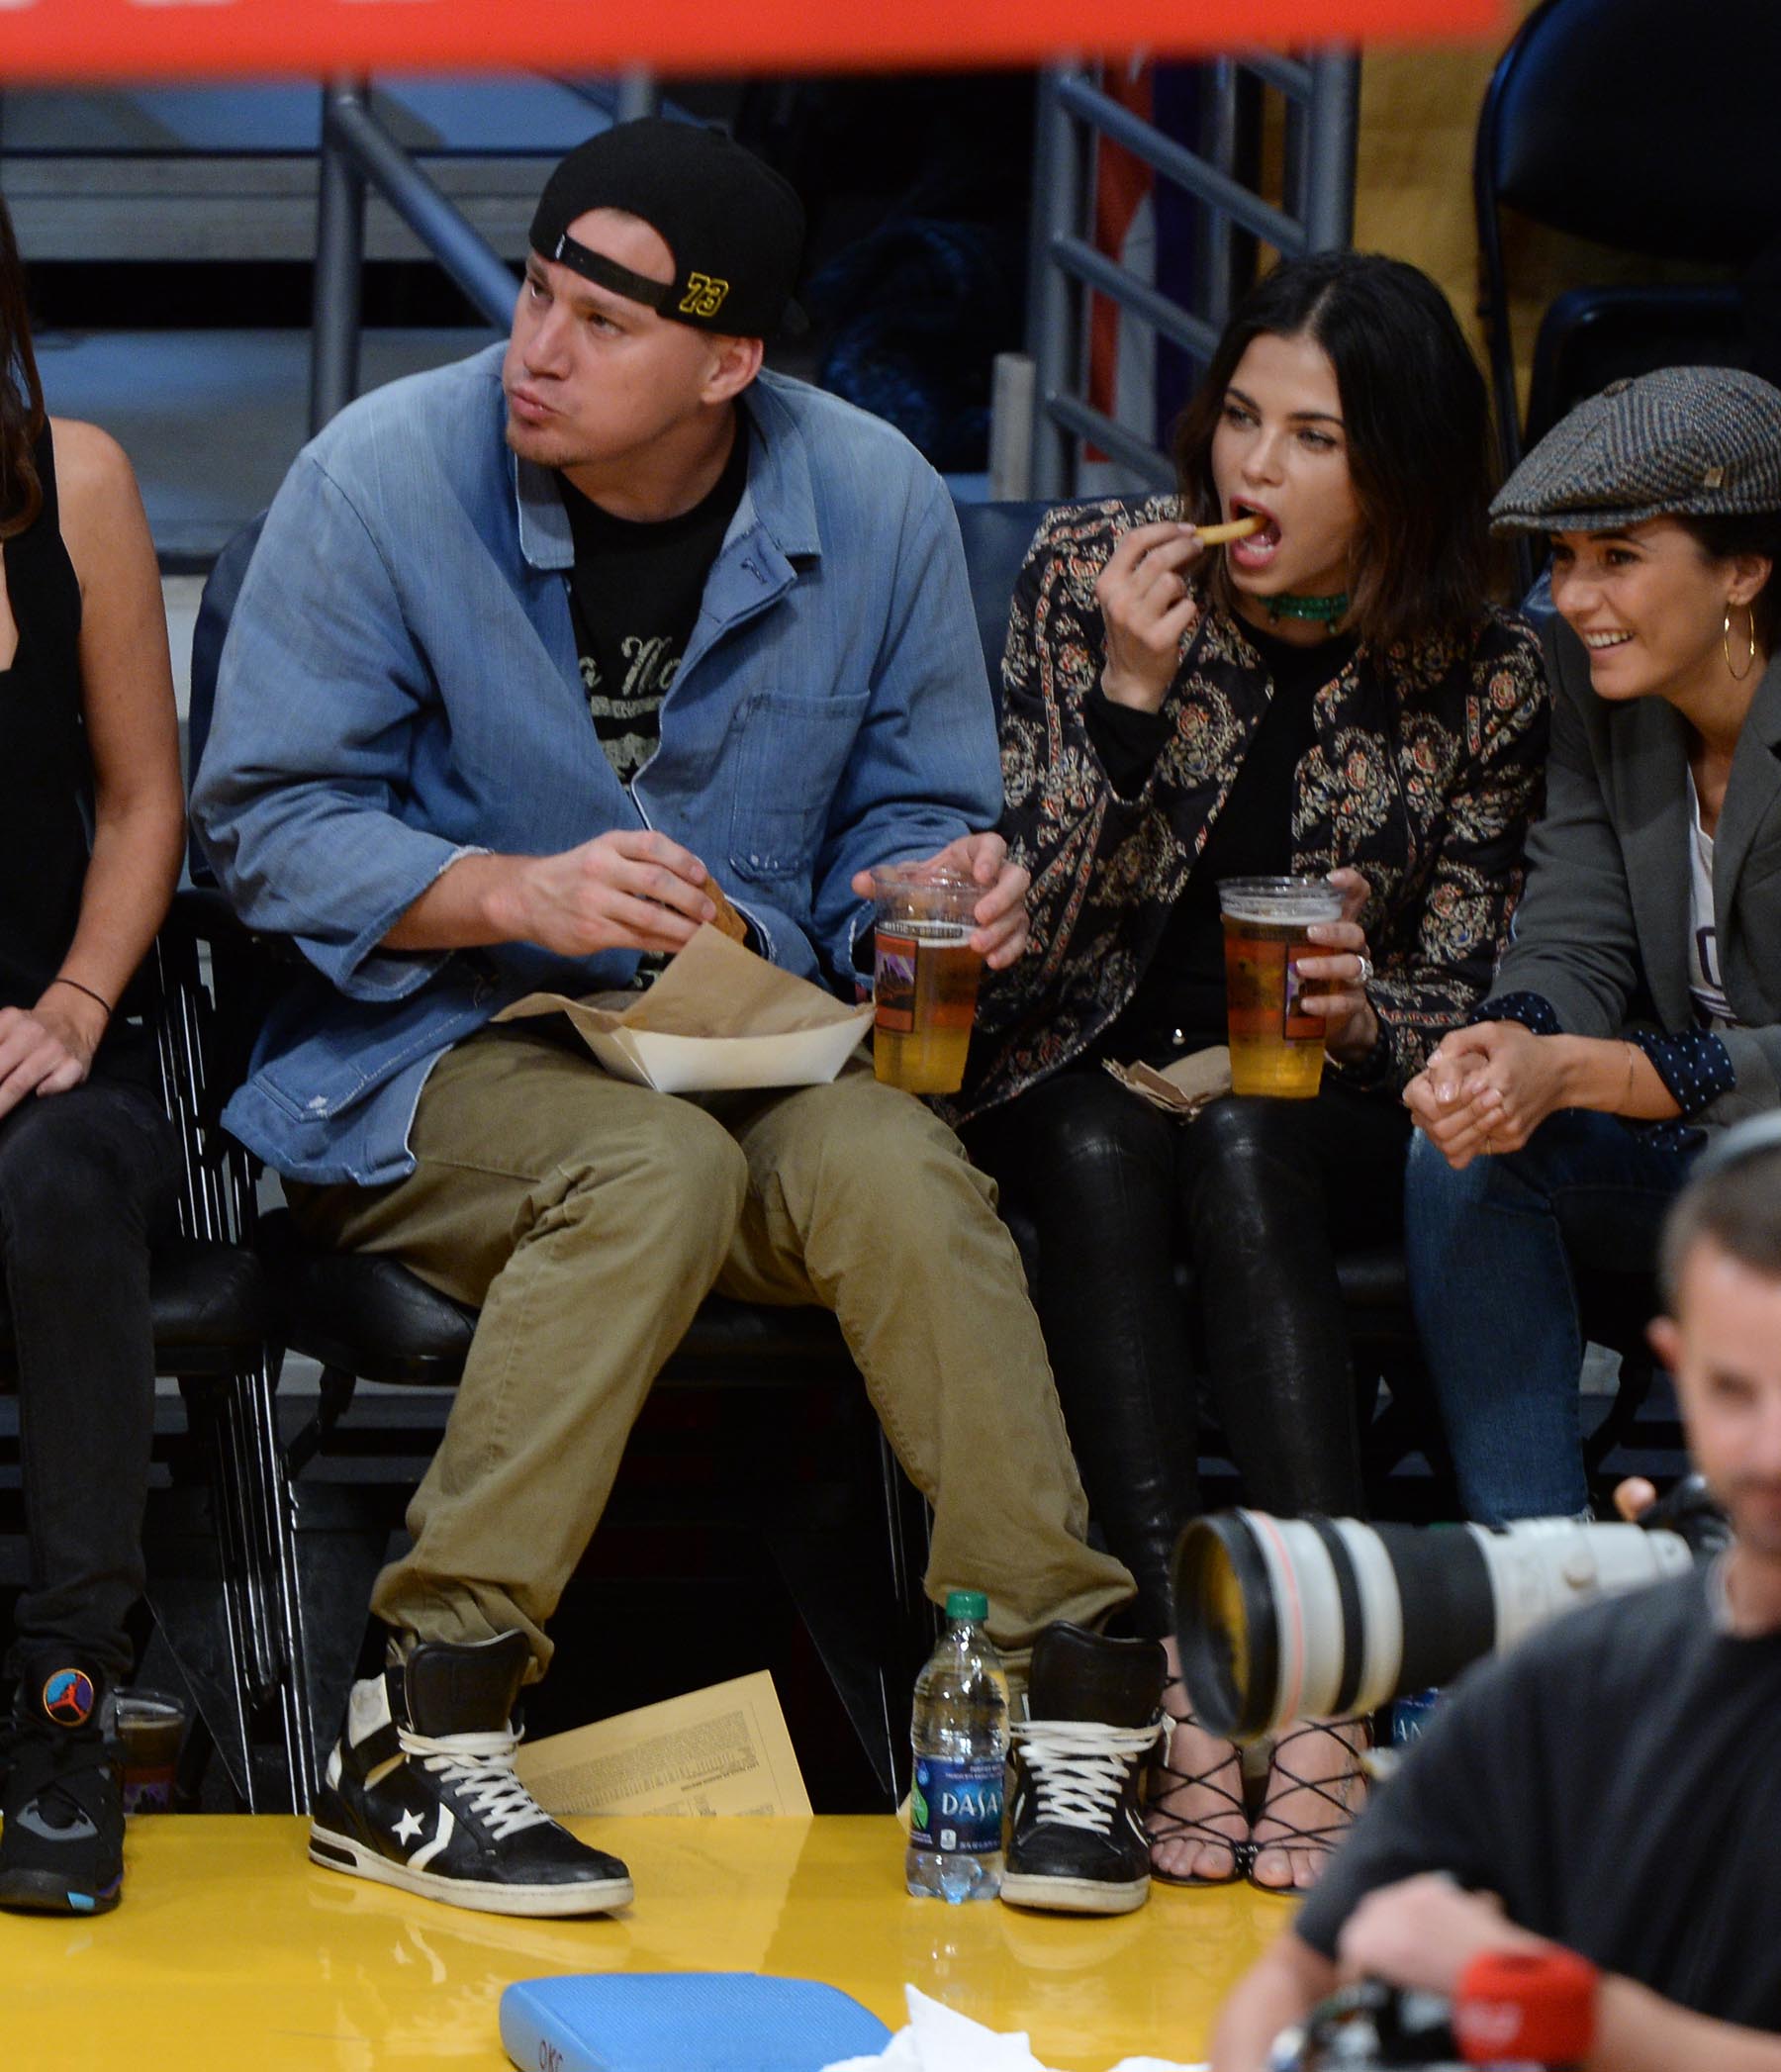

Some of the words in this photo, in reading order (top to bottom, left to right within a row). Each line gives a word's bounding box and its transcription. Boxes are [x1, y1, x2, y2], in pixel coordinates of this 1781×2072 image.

[680, 272, 729, 317] 73
[1393, 1719, 1423, 1742] AN
[941, 1788, 1003, 1822] DASA
